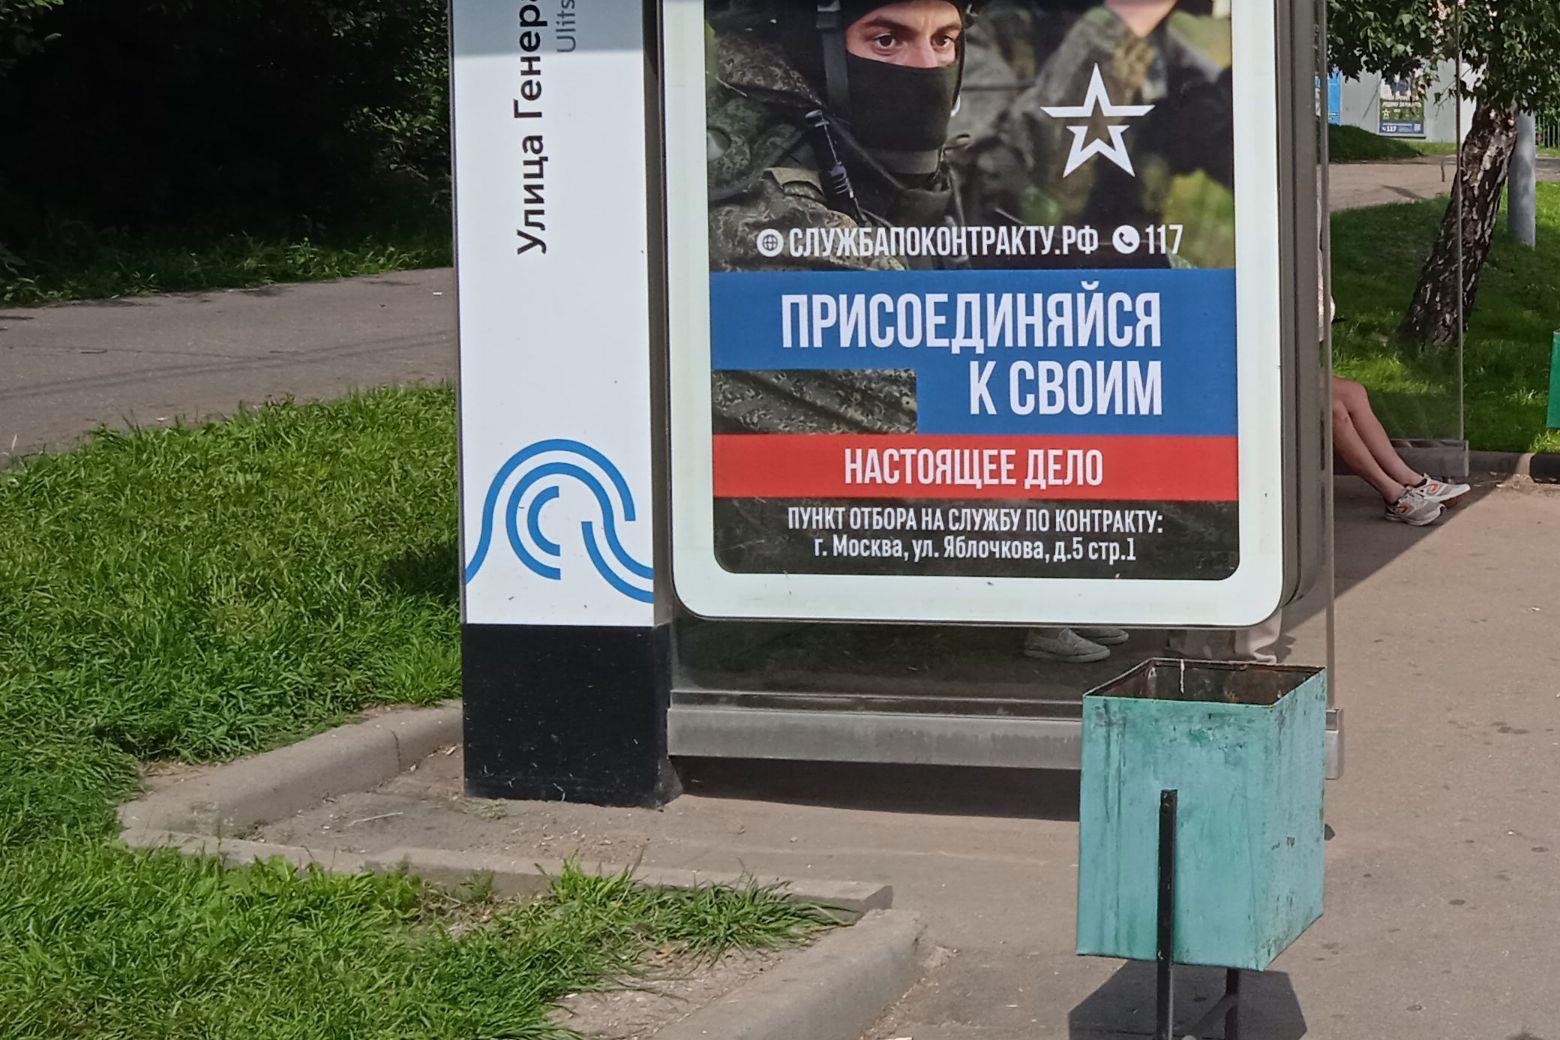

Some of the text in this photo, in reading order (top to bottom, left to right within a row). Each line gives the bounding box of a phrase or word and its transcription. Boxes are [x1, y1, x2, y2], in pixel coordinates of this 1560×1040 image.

[516, 134, 549, 255] Улица
[789, 224, 1183, 257] СЛУЖБАПОКОНТРАКТУ.РФ 117
[781, 281, 1161, 354] ПРИСОЕДИНЯЙСЯ
[970, 360, 1162, 415] К СВОИМ
[845, 448, 1103, 490] НАСТОЯЩЕЕ ДЕЛО
[788, 507, 1163, 534] ПУНКТ ОТБОРА НА СЛУЖБУ ПО КОНТРАКТУ:
[814, 534, 1136, 565] г. Москва, ул. Яблочкова, д.5 стр.1
